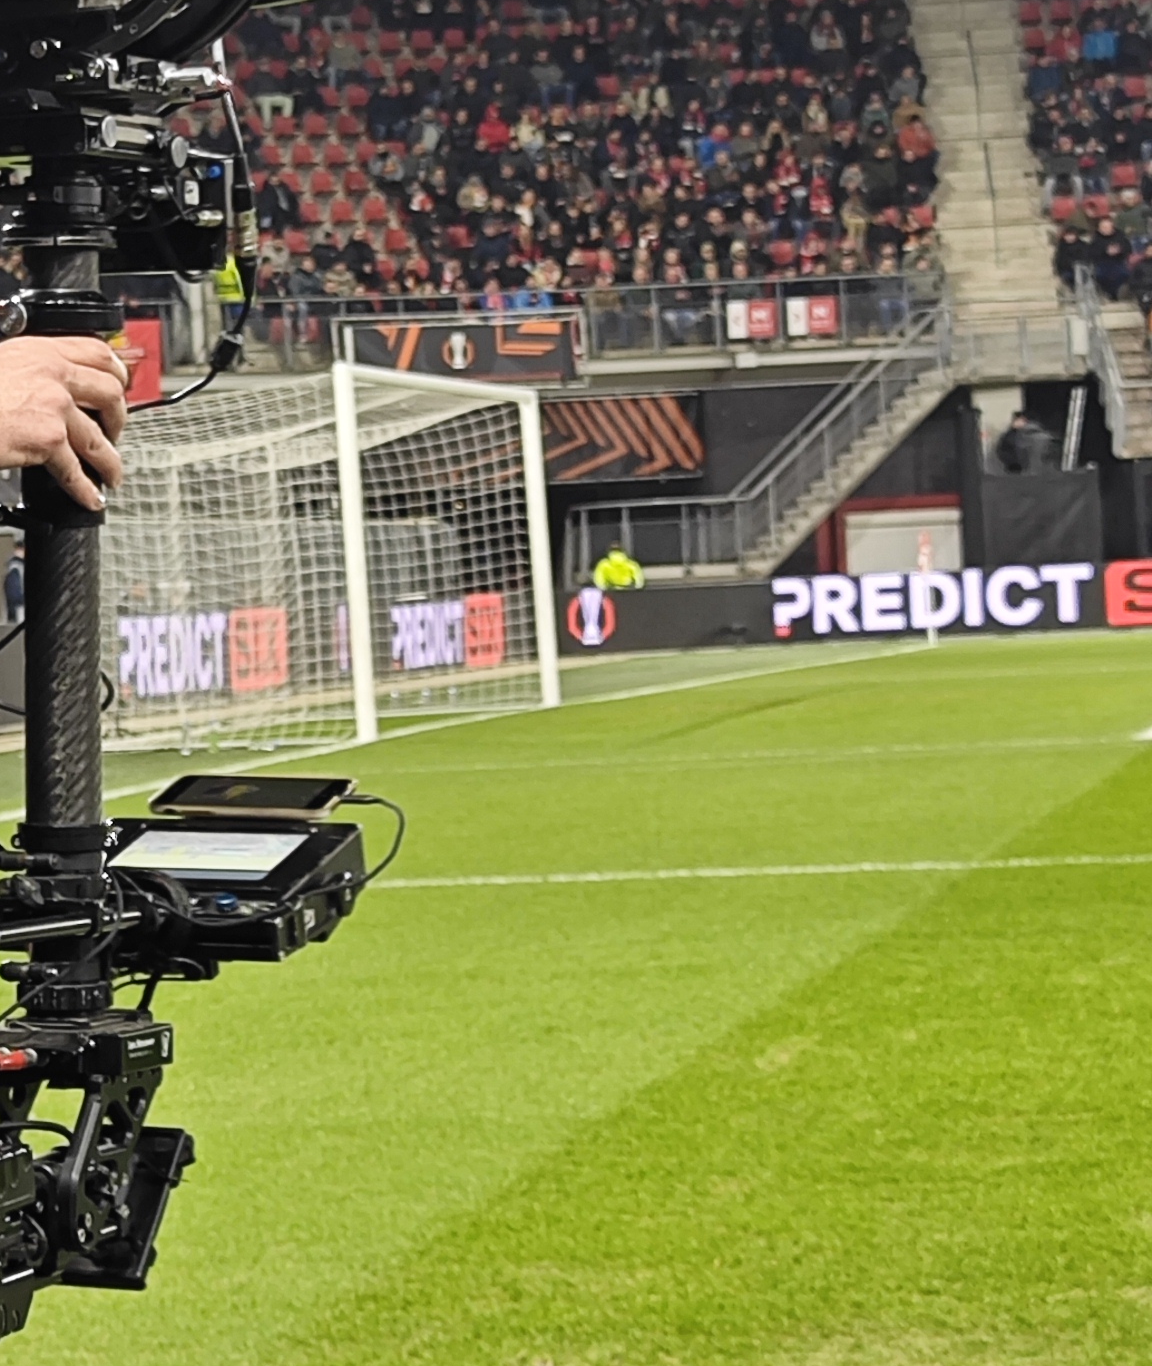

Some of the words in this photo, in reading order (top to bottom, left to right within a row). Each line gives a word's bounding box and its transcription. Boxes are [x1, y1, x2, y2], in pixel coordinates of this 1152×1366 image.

[391, 600, 465, 671] PREDICT
[771, 562, 1095, 636] PREDICT
[118, 611, 228, 697] PREDICT
